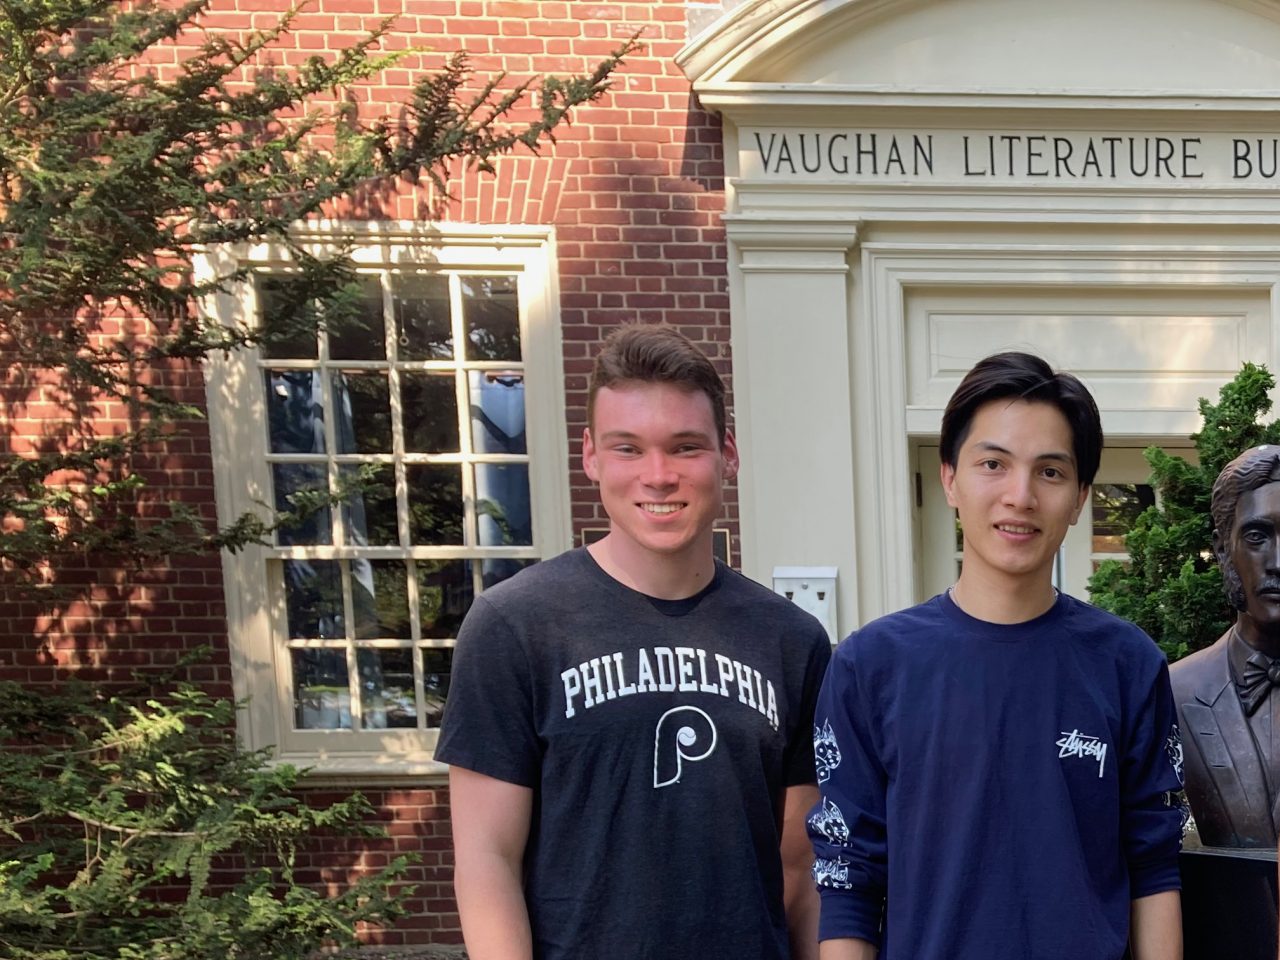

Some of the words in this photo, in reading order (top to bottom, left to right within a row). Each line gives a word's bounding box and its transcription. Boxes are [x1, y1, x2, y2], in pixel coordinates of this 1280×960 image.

[754, 132, 934, 175] VAUGHAN
[962, 135, 1204, 178] LITERATURE
[560, 646, 780, 732] PHILADELPHIA
